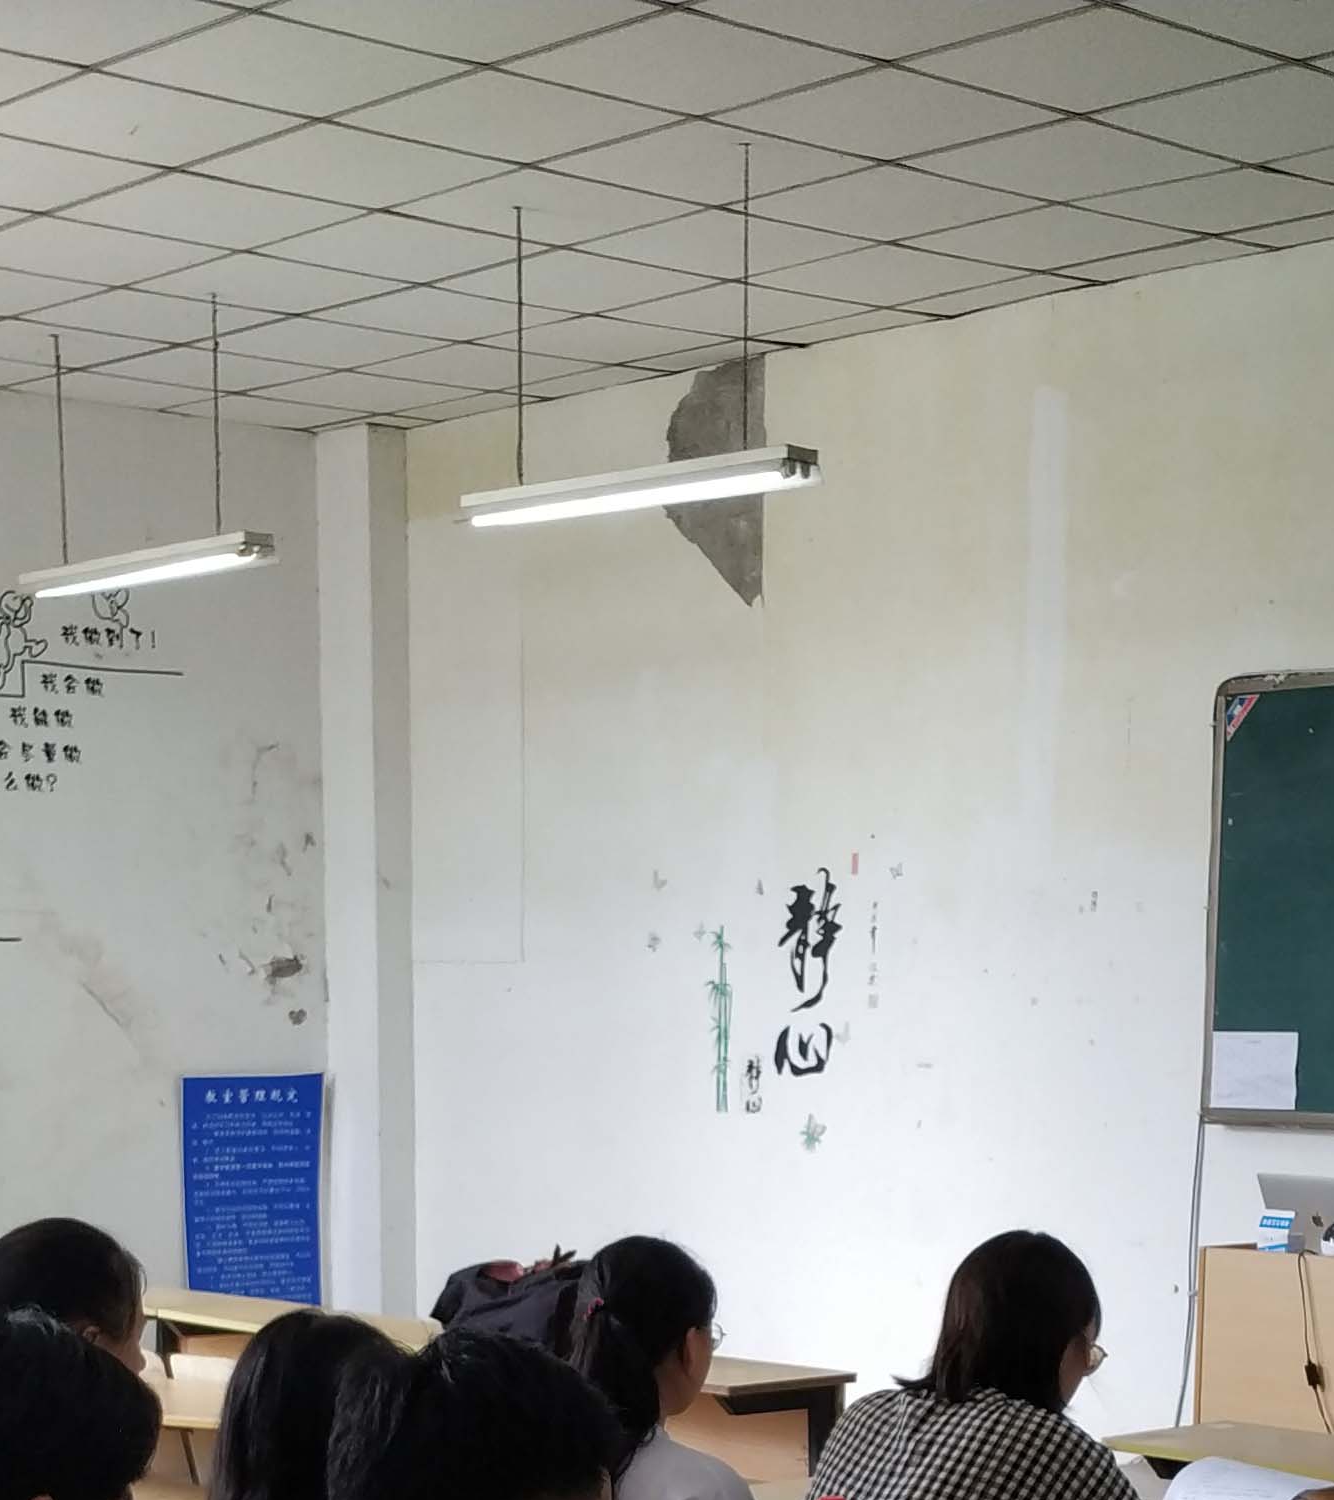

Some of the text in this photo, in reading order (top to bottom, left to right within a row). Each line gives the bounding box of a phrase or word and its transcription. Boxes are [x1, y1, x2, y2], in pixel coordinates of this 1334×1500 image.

[61, 624, 158, 651] 我做到了!
[40, 673, 105, 698] 我会做
[10, 706, 74, 730] 我能做
